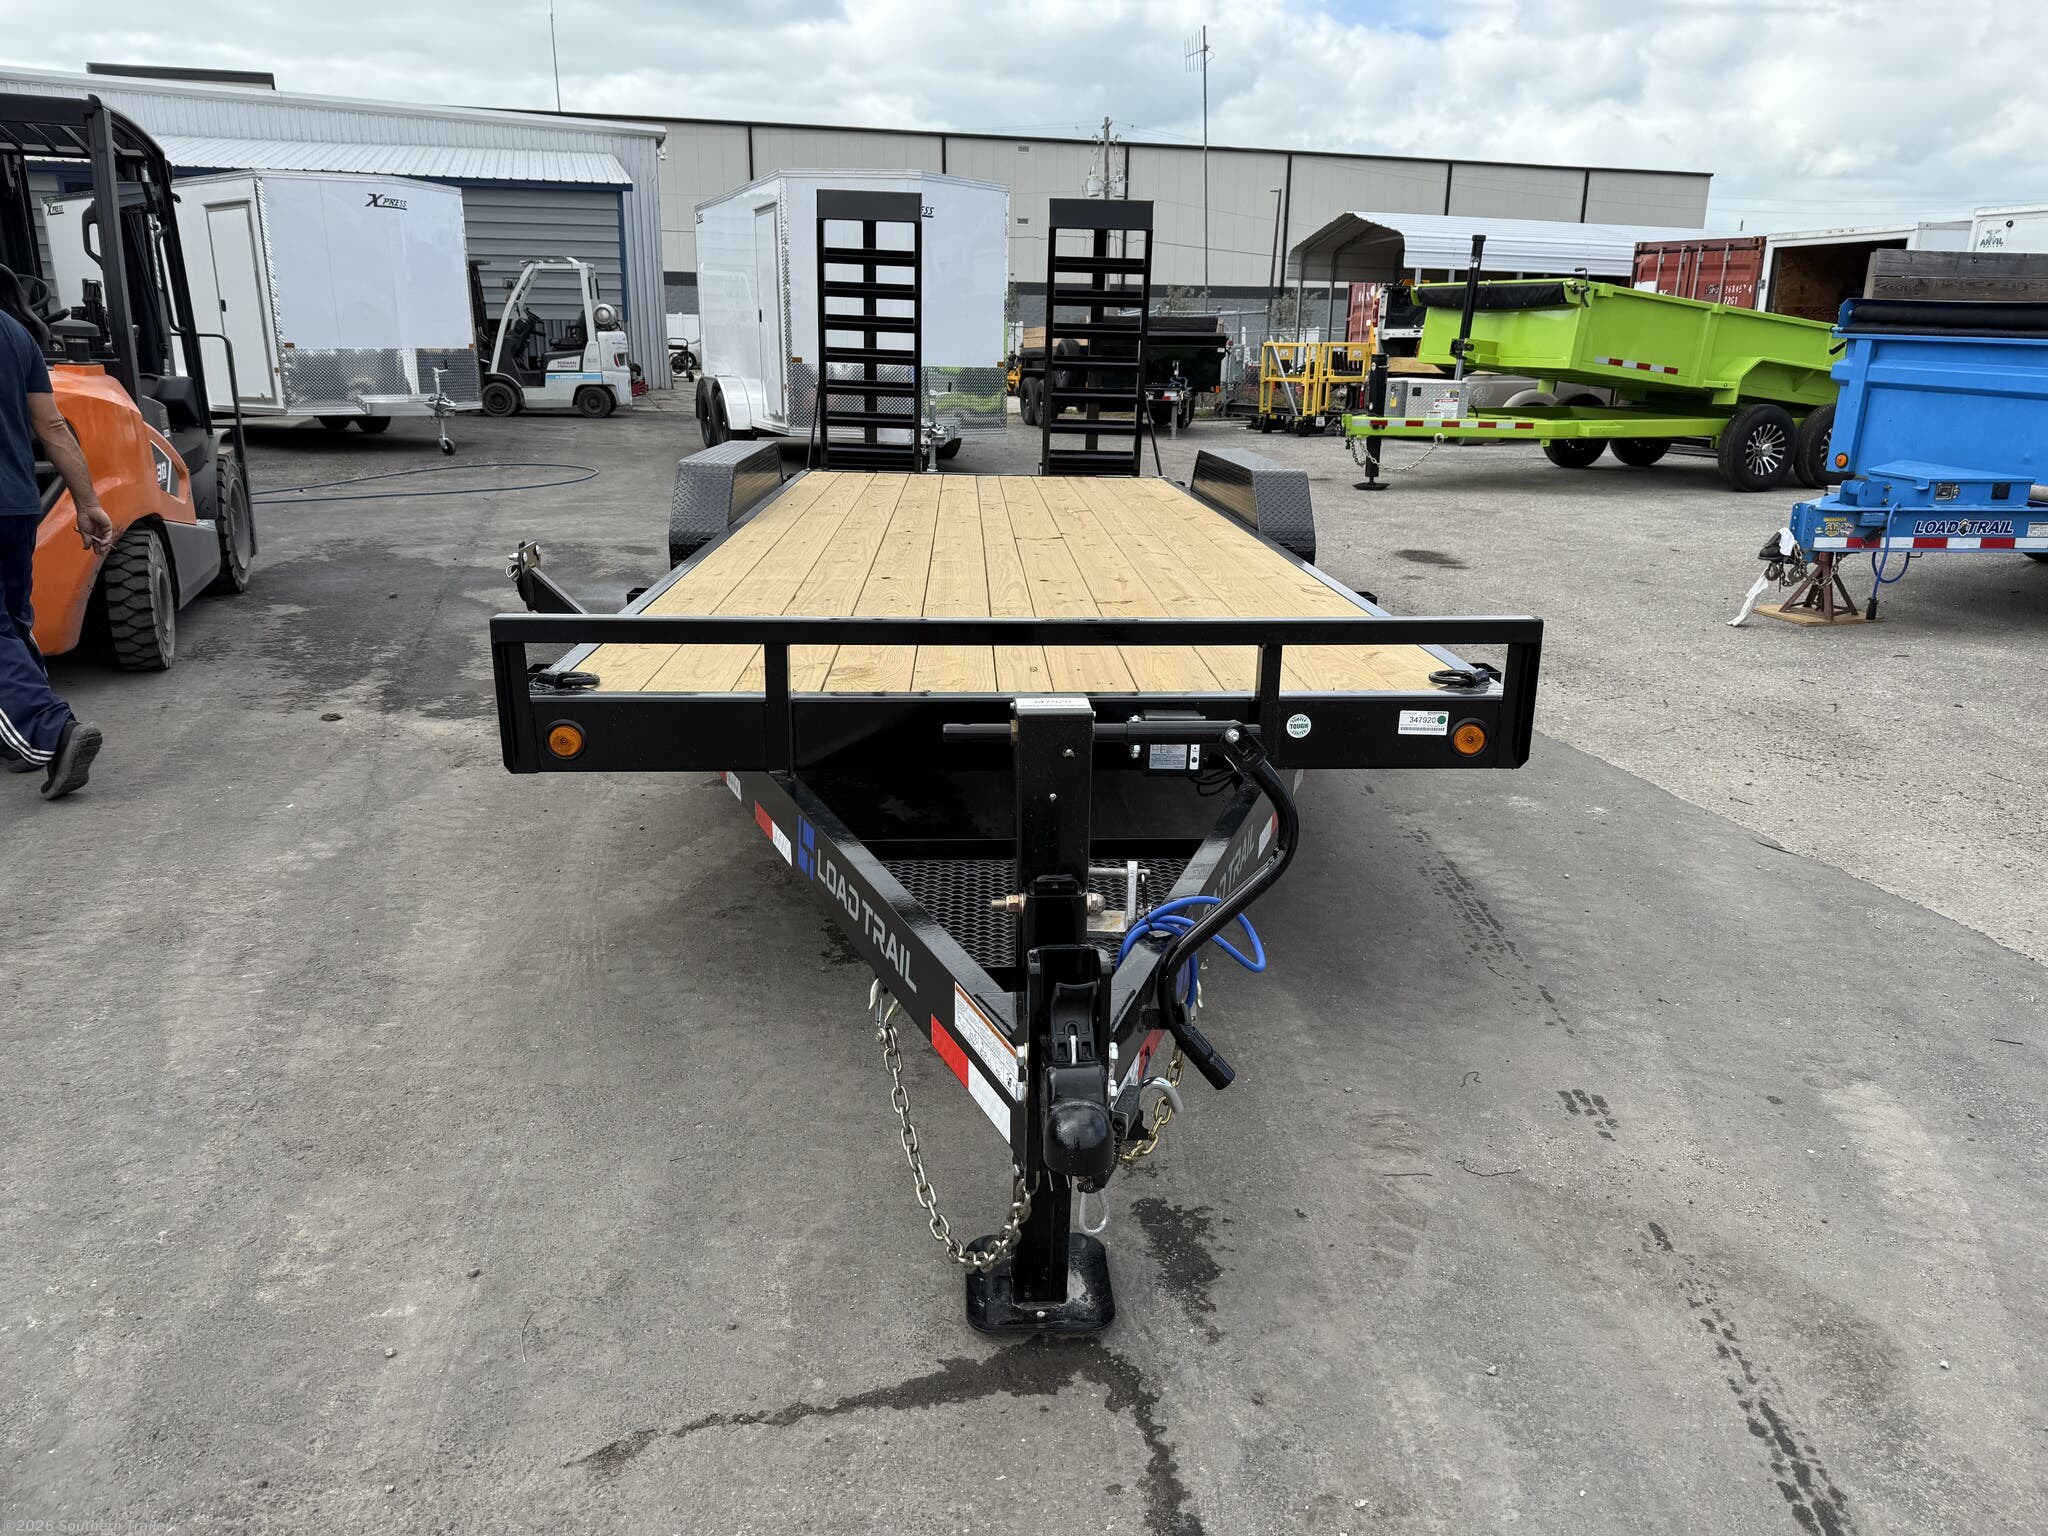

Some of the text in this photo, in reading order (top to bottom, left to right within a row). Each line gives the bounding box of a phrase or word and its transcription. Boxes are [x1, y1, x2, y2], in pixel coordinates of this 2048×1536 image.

[364, 193, 407, 210] XPRESS
[1980, 237, 2004, 246] ANVIL
[1913, 520, 1959, 535] LOAD
[1968, 520, 2014, 535] TRAIL
[1409, 716, 1437, 724] 347920
[1228, 824, 1255, 893] TRAIL
[817, 848, 917, 994] LOAD TRAIL
